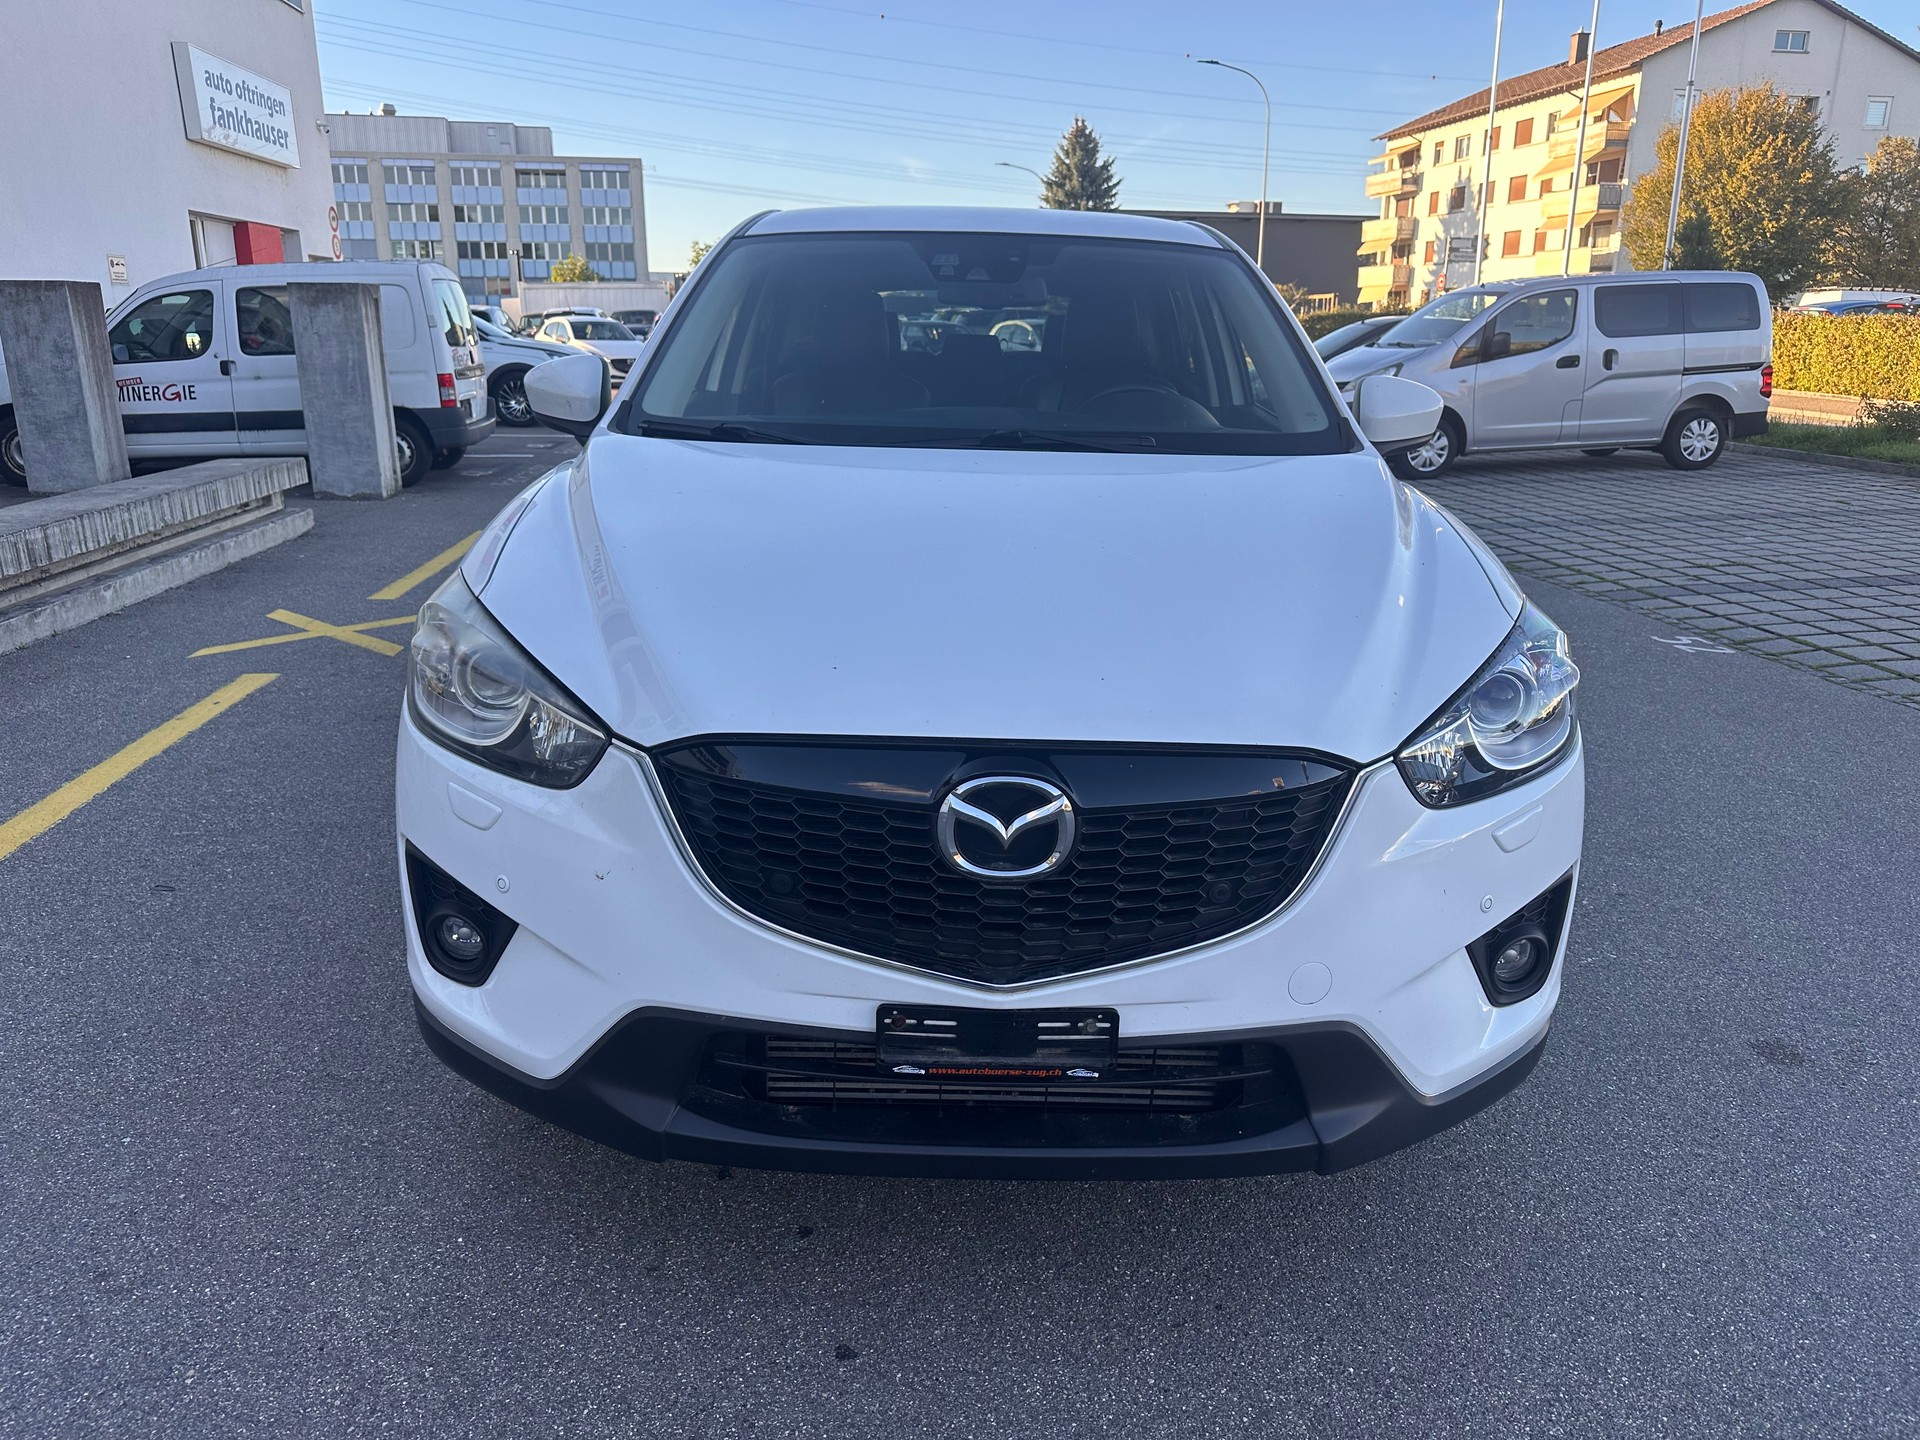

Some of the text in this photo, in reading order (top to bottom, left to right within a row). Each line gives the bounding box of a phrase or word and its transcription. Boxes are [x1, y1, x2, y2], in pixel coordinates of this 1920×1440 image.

[204, 69, 286, 118] auto oftringen
[209, 96, 289, 149] fankhauser
[929, 1067, 1062, 1077] www.autoboerse-zug.ch
